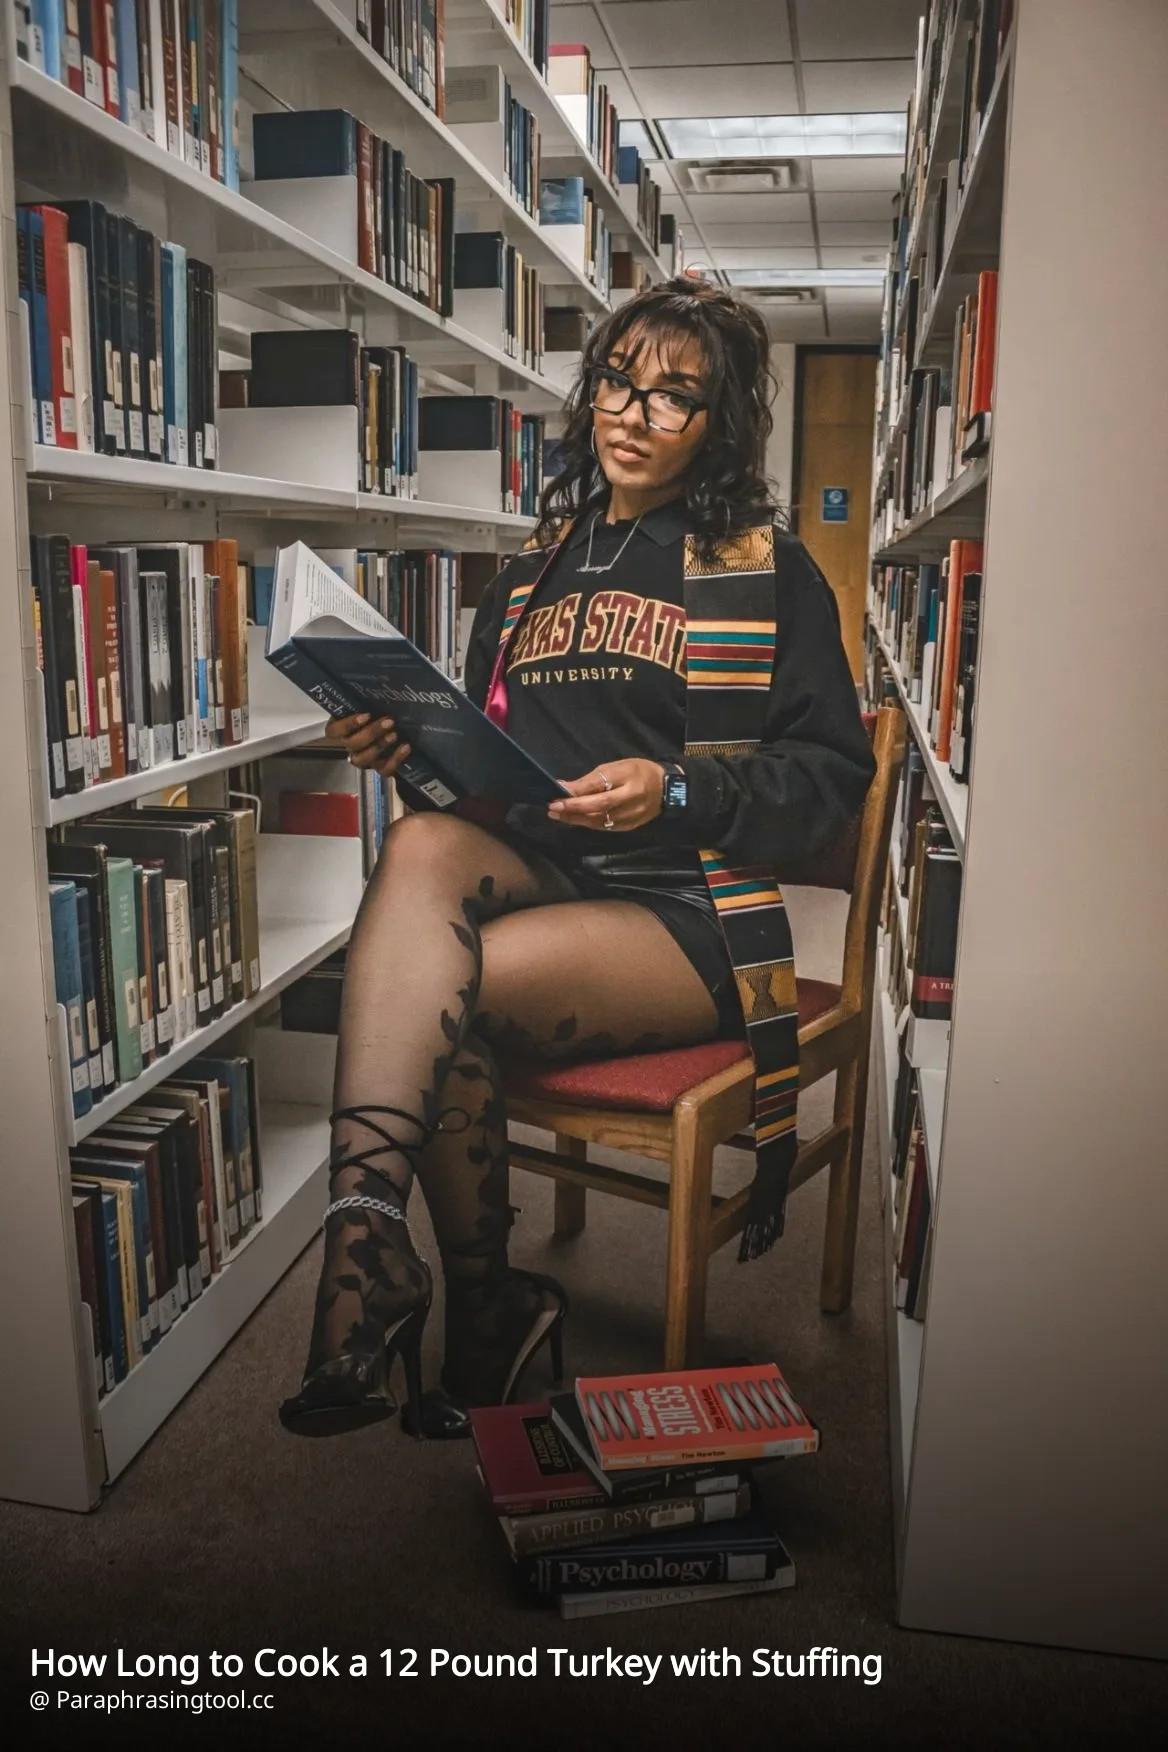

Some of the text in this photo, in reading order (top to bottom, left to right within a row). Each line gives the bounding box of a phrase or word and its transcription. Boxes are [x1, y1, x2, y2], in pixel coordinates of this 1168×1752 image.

[165, 38, 177, 118] PLATO
[511, 592, 582, 665] EXAS
[520, 667, 634, 685] UNIVERSITY
[349, 679, 459, 710] Psychology
[647, 1385, 701, 1437] STRESS
[700, 1388, 721, 1414] Newton
[681, 1452, 695, 1460] Tim
[696, 1449, 726, 1458] Newton
[528, 1517, 604, 1543] APPLIED
[614, 1499, 705, 1530] PSYCHO
[559, 1555, 712, 1586] Psychology
[606, 1589, 697, 1610] PSYCHOLOGY
